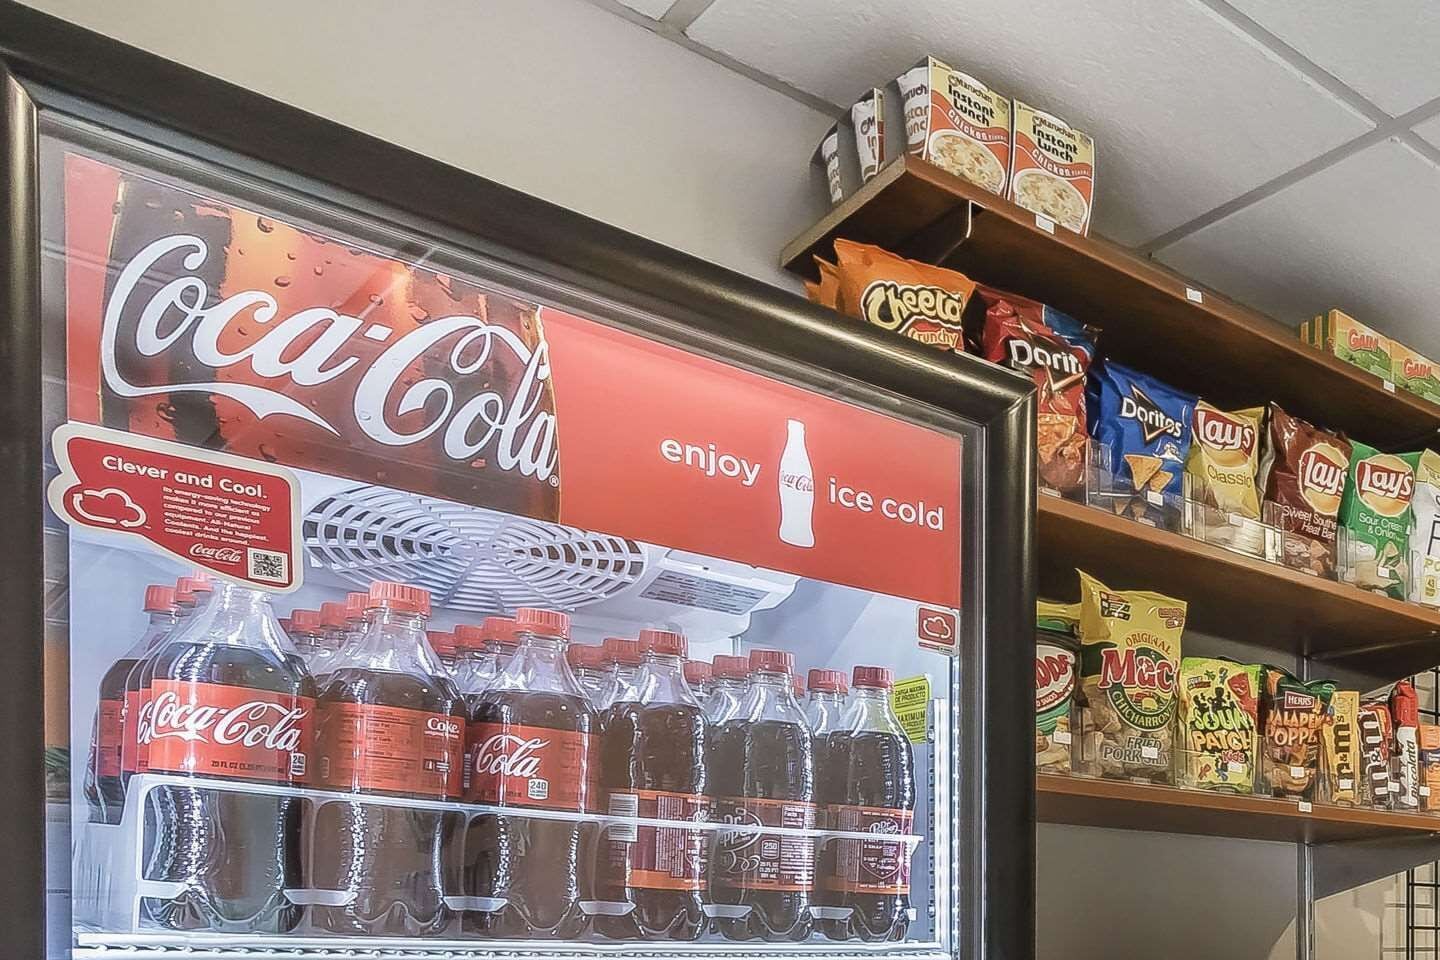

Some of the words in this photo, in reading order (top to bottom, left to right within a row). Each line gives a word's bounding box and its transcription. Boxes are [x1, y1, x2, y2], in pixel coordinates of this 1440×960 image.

[947, 85, 995, 119] Instant
[953, 99, 990, 127] Lunch
[1032, 125, 1078, 155] Instant
[1037, 140, 1073, 163] Lunch
[861, 280, 963, 330] Cheeto
[907, 327, 959, 350] Crunchy
[101, 234, 558, 480] Coca-Cola
[1121, 397, 1184, 438] Doritos
[1195, 410, 1256, 453] Lay's
[102, 455, 168, 480] Clever
[174, 472, 213, 489] and
[219, 478, 268, 499] Cool.
[660, 438, 762, 487] enjoy
[828, 477, 874, 513] ice
[881, 500, 945, 531] cold
[1206, 463, 1254, 488] Classic
[1360, 461, 1414, 500] Lay's
[1283, 505, 1313, 522] Sweet
[1358, 512, 1379, 527] Sour
[189, 543, 243, 562] Coca-Cola
[1125, 632, 1171, 656] ORIGINAL
[151, 691, 309, 751] Coca-Cola
[426, 716, 460, 734] Coke
